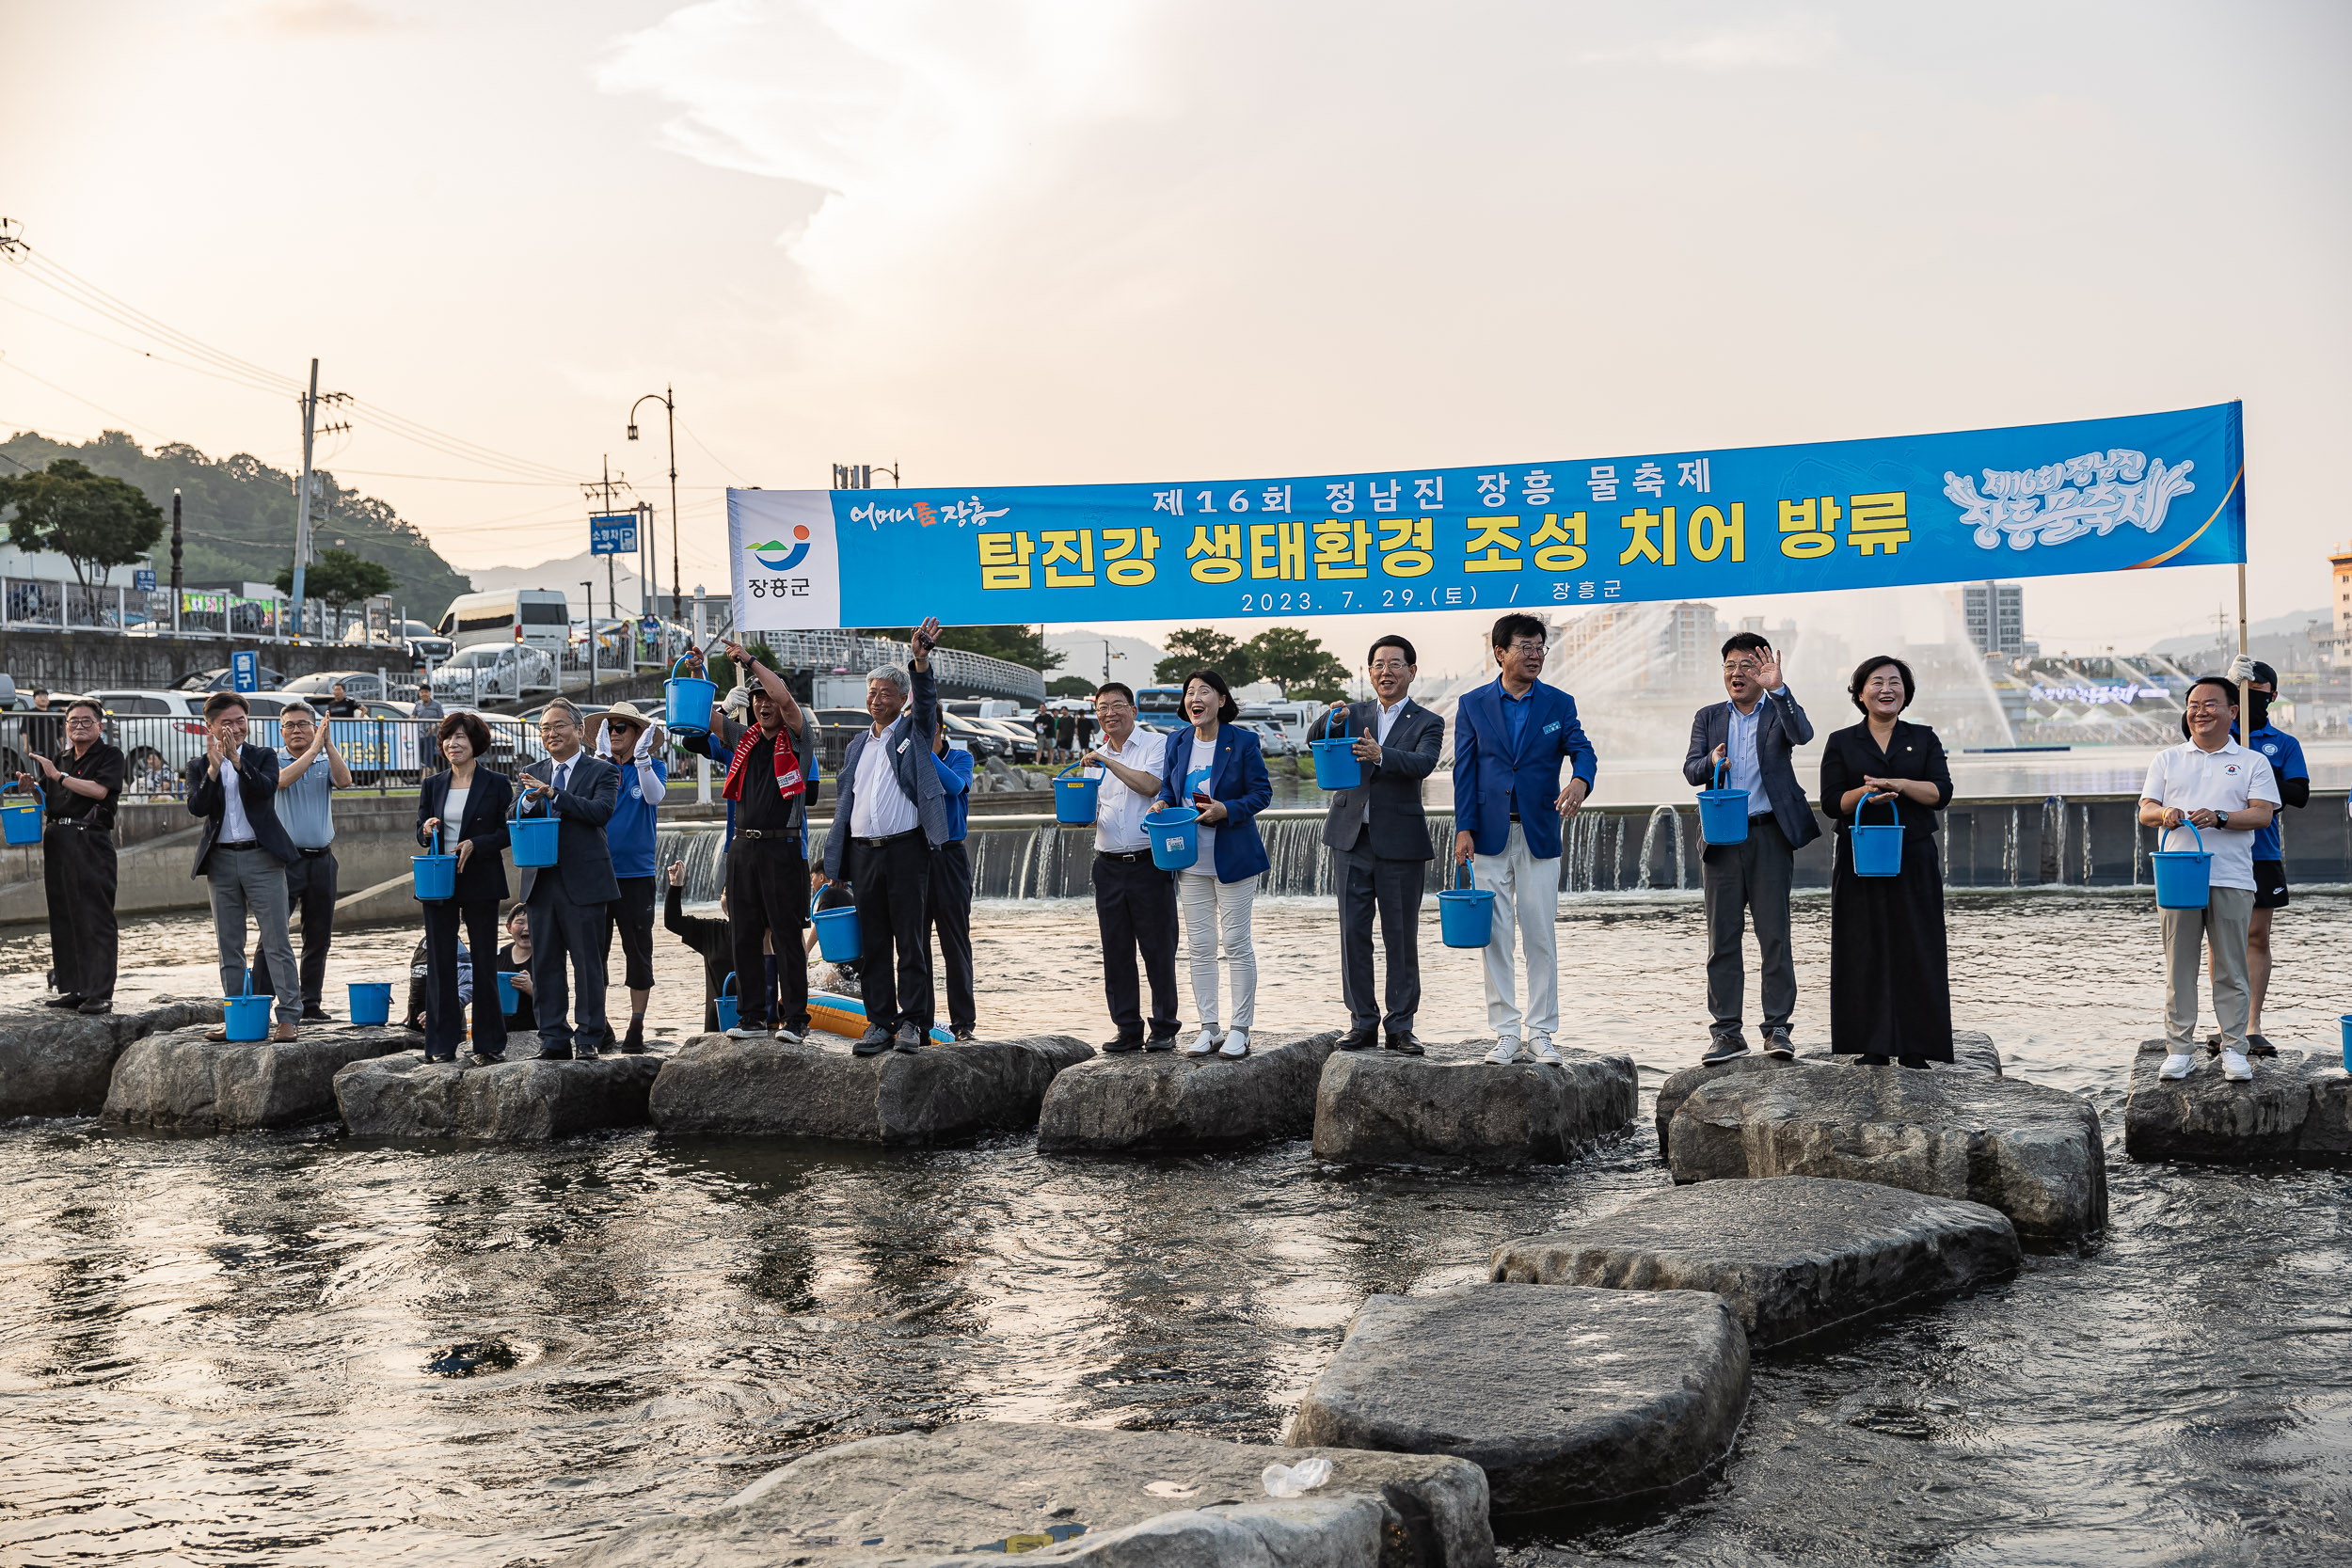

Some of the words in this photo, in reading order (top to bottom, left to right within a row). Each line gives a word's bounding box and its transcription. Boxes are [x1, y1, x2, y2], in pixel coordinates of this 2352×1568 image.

[1152, 483, 1292, 516] 제16회
[1325, 475, 1445, 514] 정남진
[1476, 468, 1555, 508] 장흥
[1586, 456, 1711, 503] 물축제
[940, 495, 1010, 529] 장흥
[977, 526, 1161, 591] 탐진강
[1185, 516, 1435, 585] 생태환경
[1463, 510, 1589, 574] 조성
[1618, 500, 1746, 567] 치어
[1777, 490, 1912, 560] 방류
[748, 577, 811, 598] 장흥군
[1241, 591, 1323, 612] 2023.
[1341, 590, 1363, 610] 7.
[1381, 584, 1478, 608] 29.(토)
[1551, 578, 1622, 601] 장흥군
[236, 654, 252, 689] 출구
